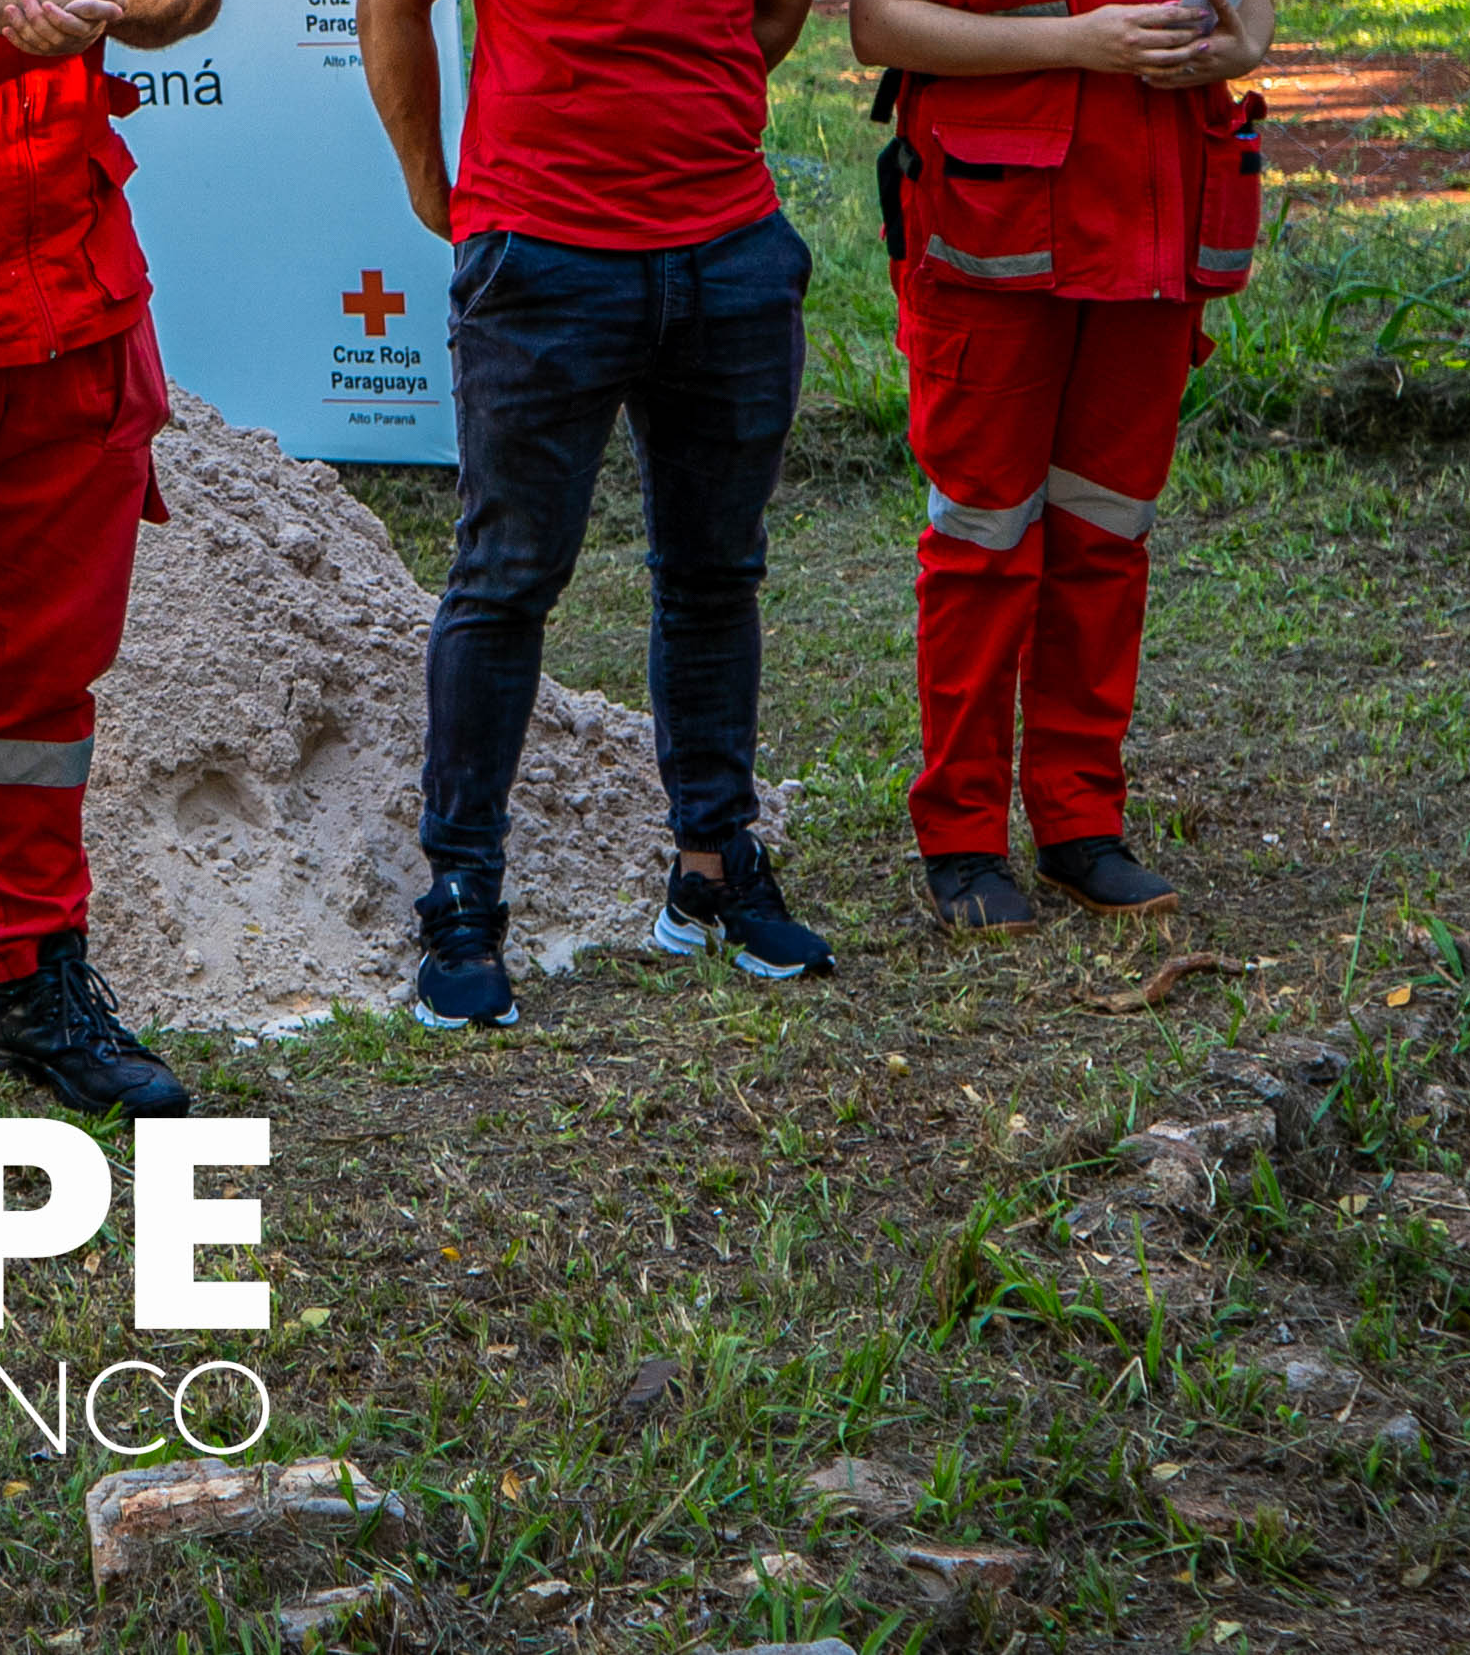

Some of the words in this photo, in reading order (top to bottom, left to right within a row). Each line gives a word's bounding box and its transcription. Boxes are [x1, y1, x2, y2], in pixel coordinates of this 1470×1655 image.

[323, 55, 346, 67] Alto
[333, 345, 375, 363] Cruz
[380, 346, 421, 368] Roja
[331, 371, 427, 394] Paraguaya
[348, 413, 371, 424] Alto
[374, 412, 416, 426] Paraná
